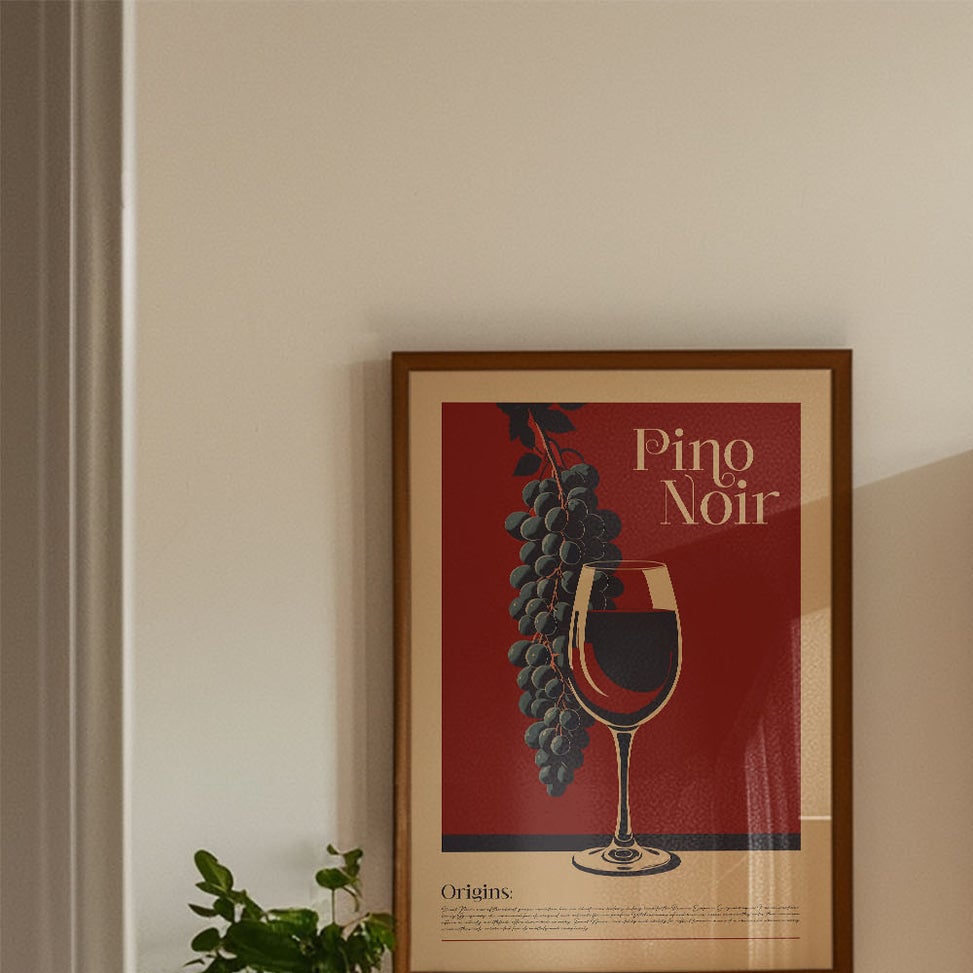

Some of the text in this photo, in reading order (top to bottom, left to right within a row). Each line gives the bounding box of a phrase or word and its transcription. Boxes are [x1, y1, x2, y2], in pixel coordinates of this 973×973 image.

[633, 428, 754, 488] Pino
[660, 474, 780, 525] Noir
[441, 883, 513, 902] Origins:
